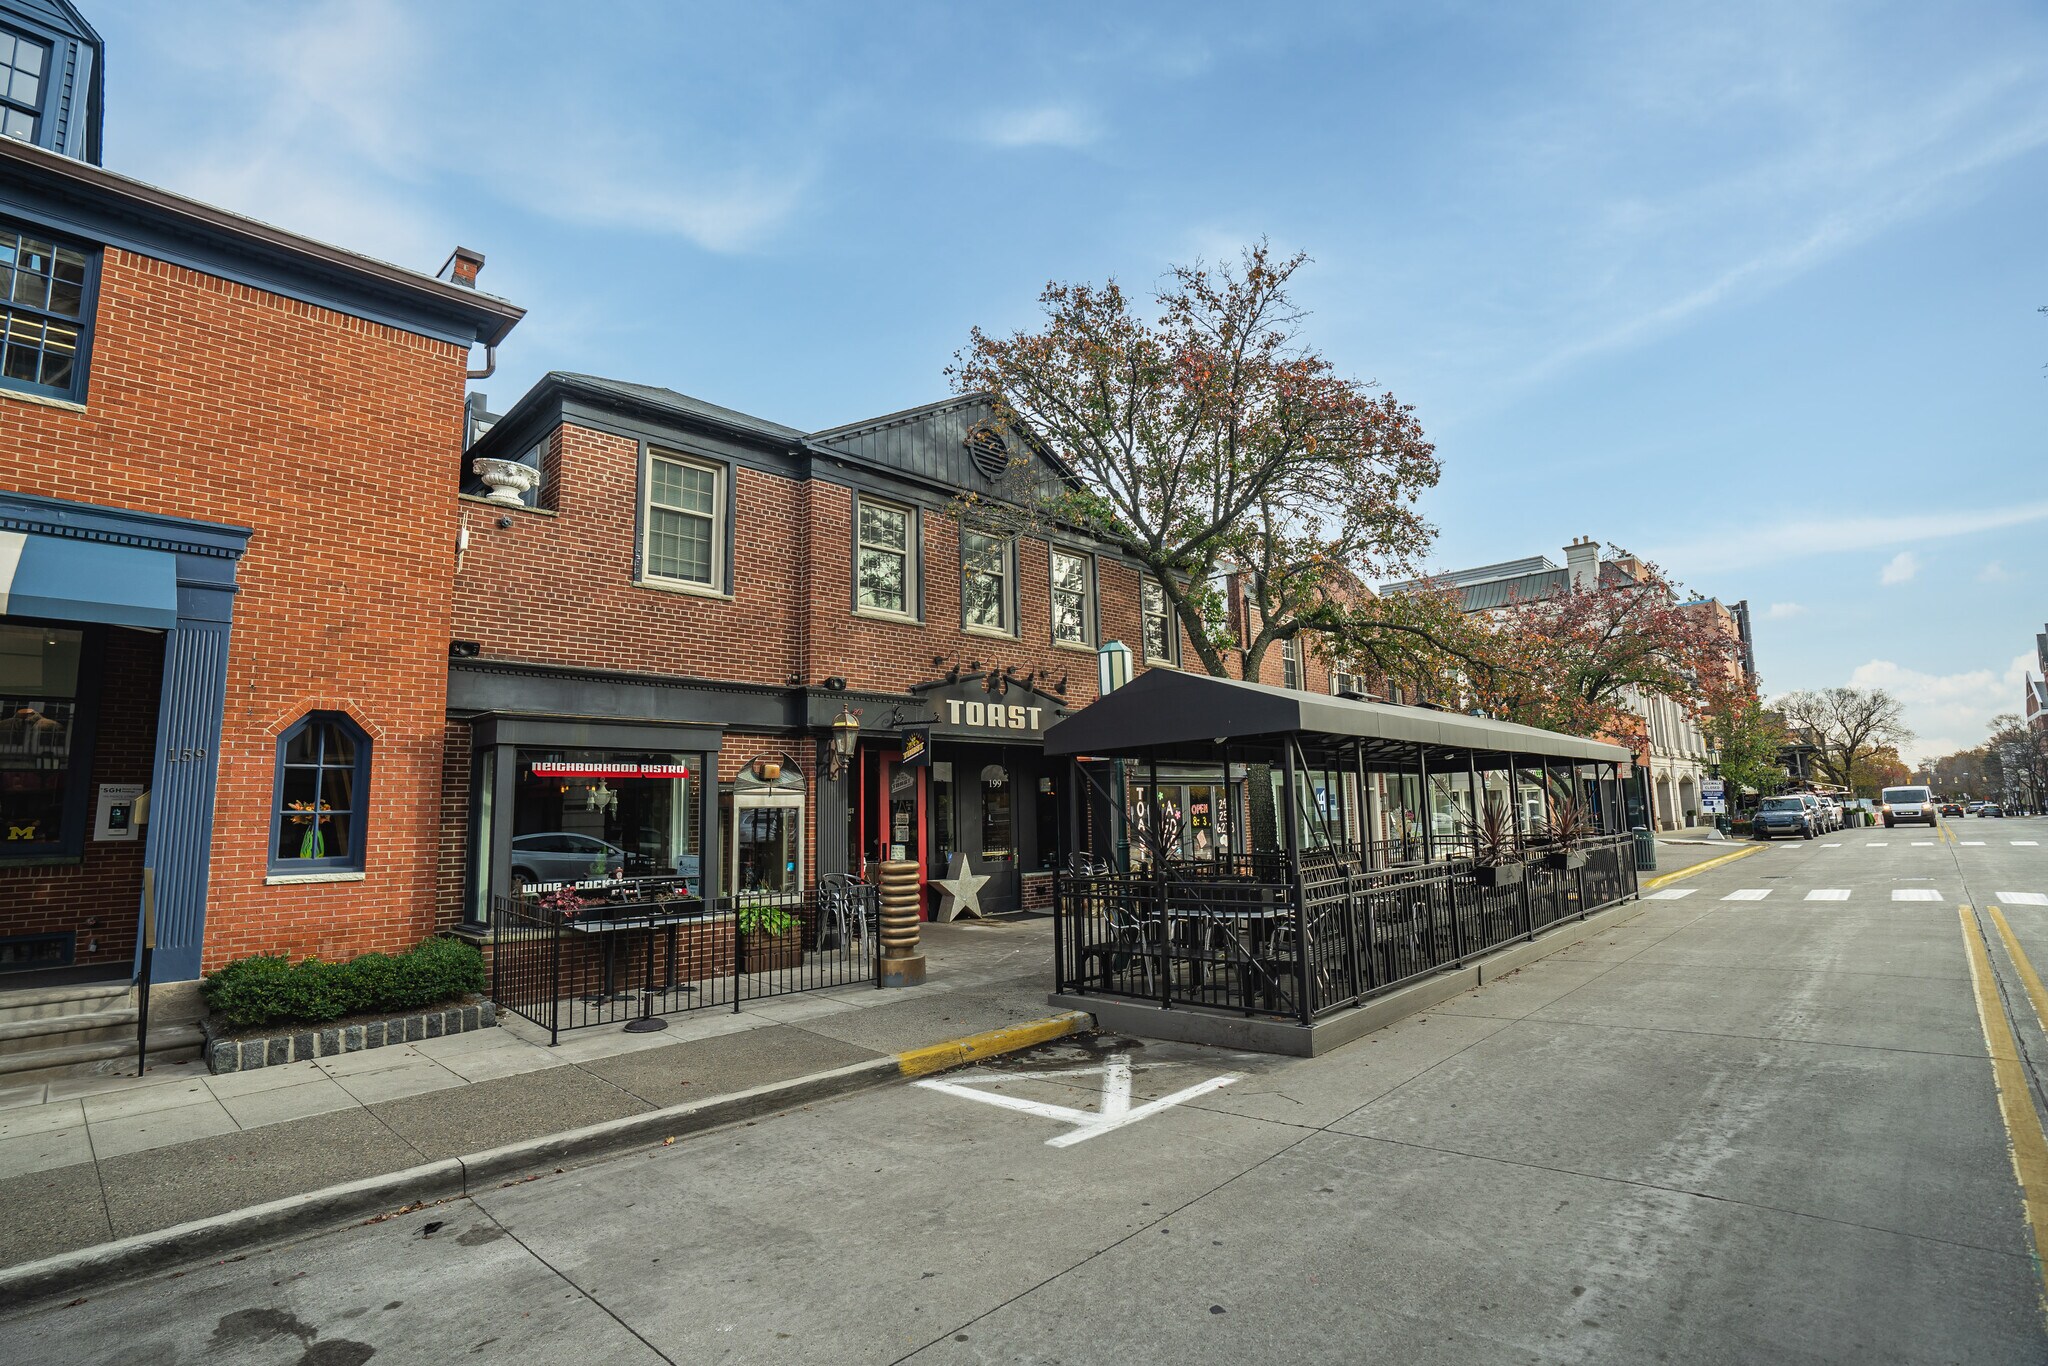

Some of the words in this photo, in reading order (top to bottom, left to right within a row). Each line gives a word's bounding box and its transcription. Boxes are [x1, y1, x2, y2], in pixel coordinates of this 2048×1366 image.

[946, 699, 1042, 730] TOAST
[168, 747, 207, 762] 159
[640, 764, 685, 774] BISTRO
[989, 779, 1003, 788] 199
[1191, 803, 1209, 815] OPEN
[8, 826, 36, 840] M
